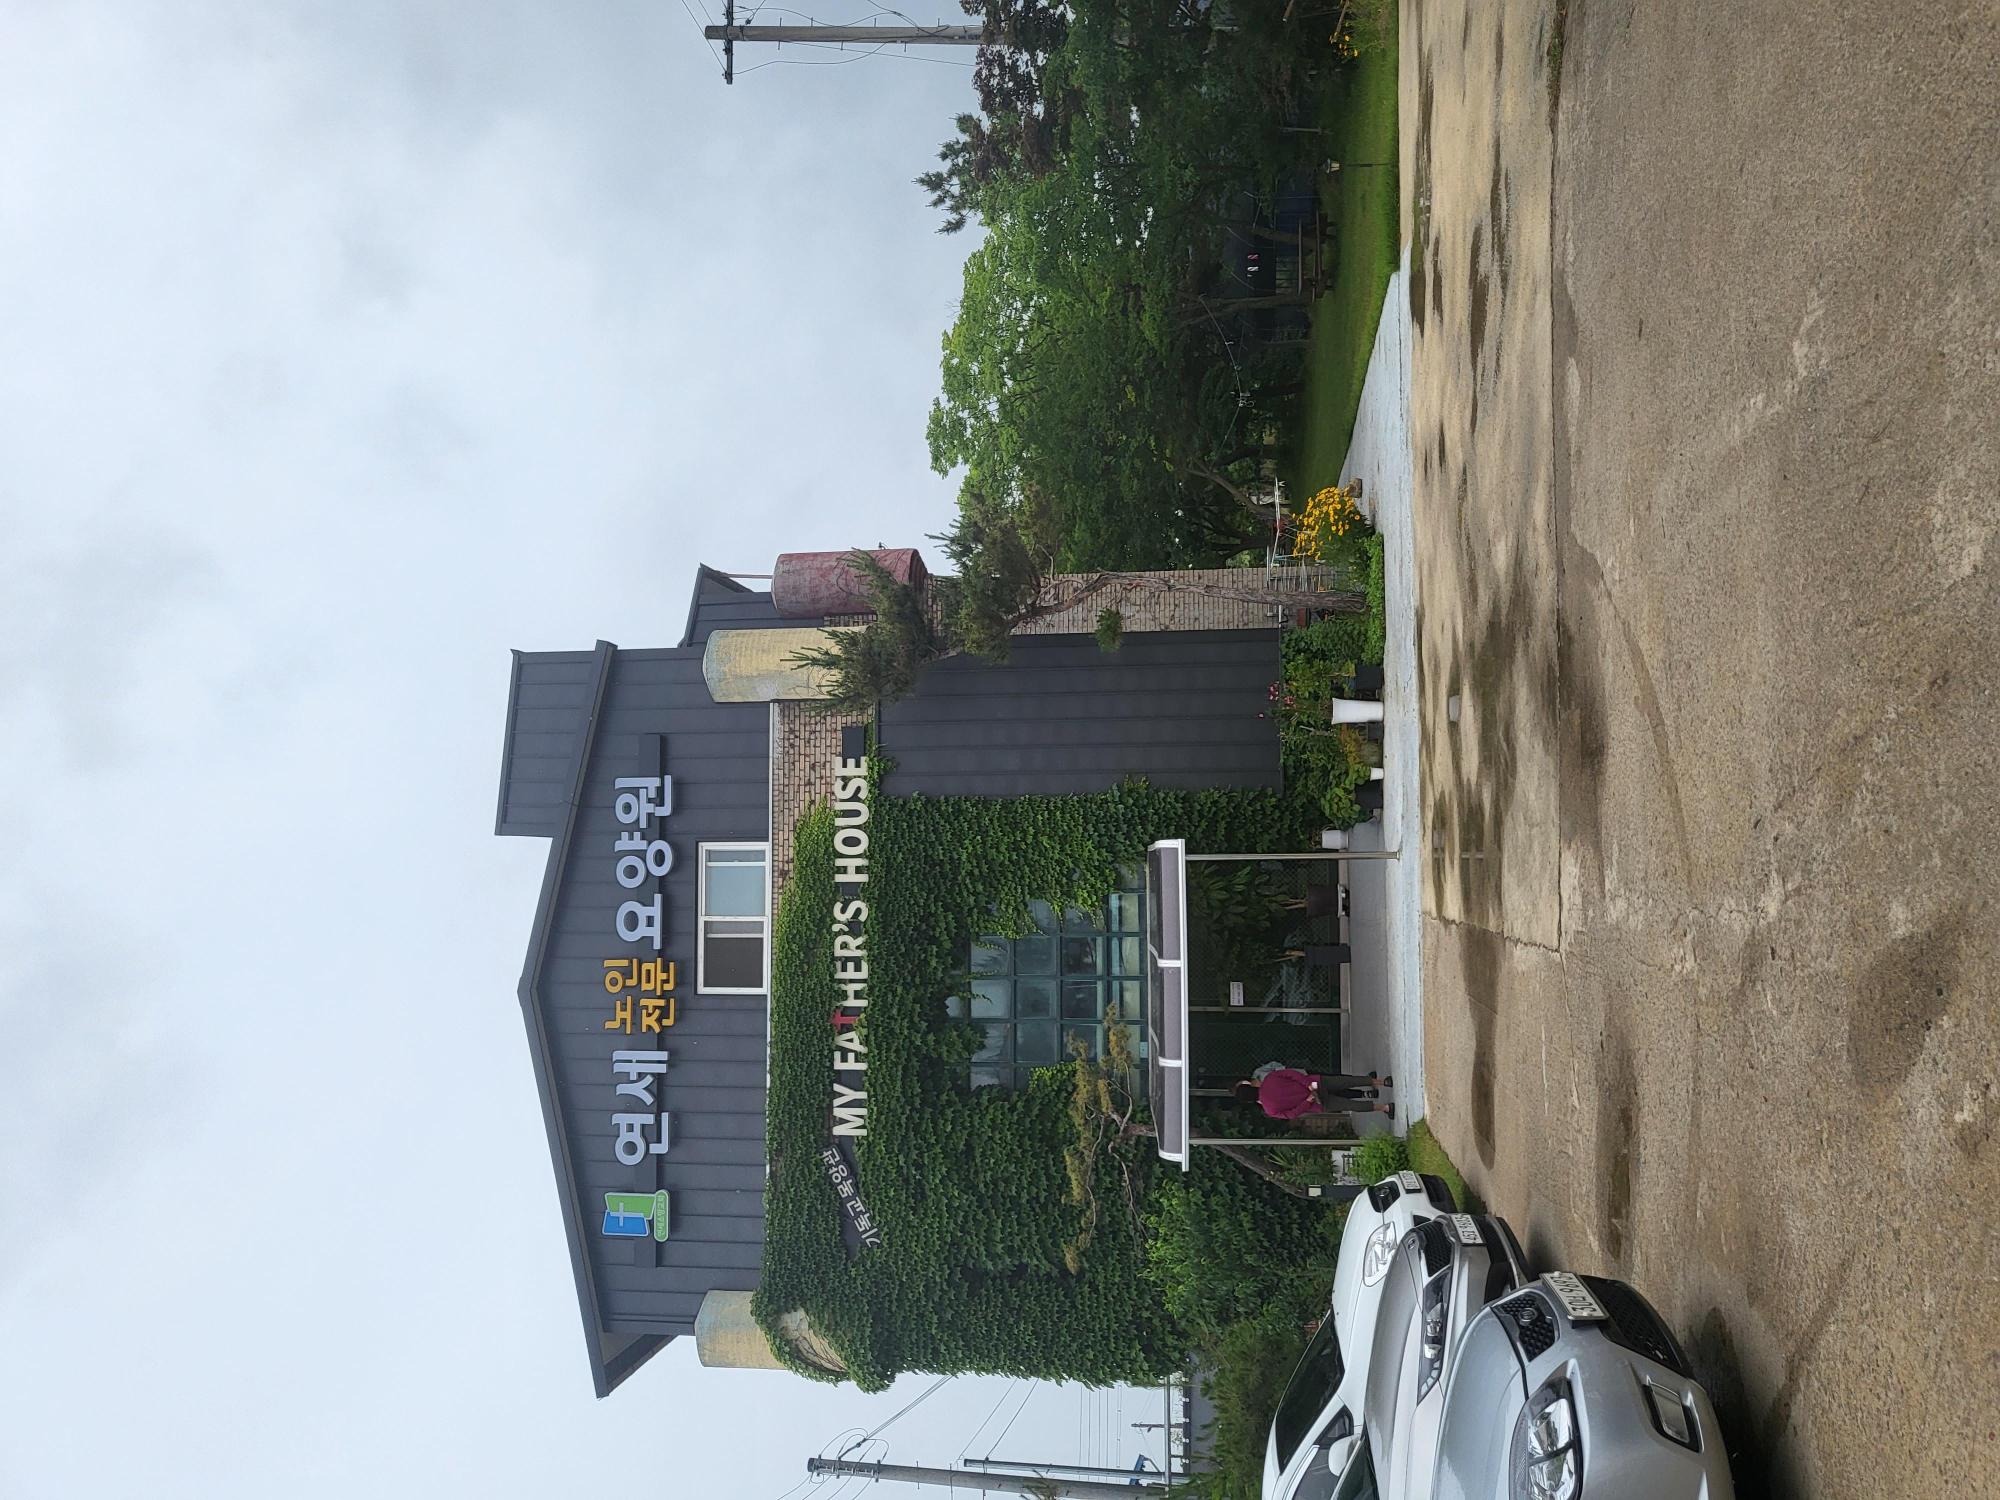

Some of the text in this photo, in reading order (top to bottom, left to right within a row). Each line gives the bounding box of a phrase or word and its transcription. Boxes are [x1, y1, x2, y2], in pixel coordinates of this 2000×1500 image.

[604, 775, 674, 1165] 연세 노인 전문 요양원
[830, 756, 869, 1136] MY FATHER'S HOUSE
